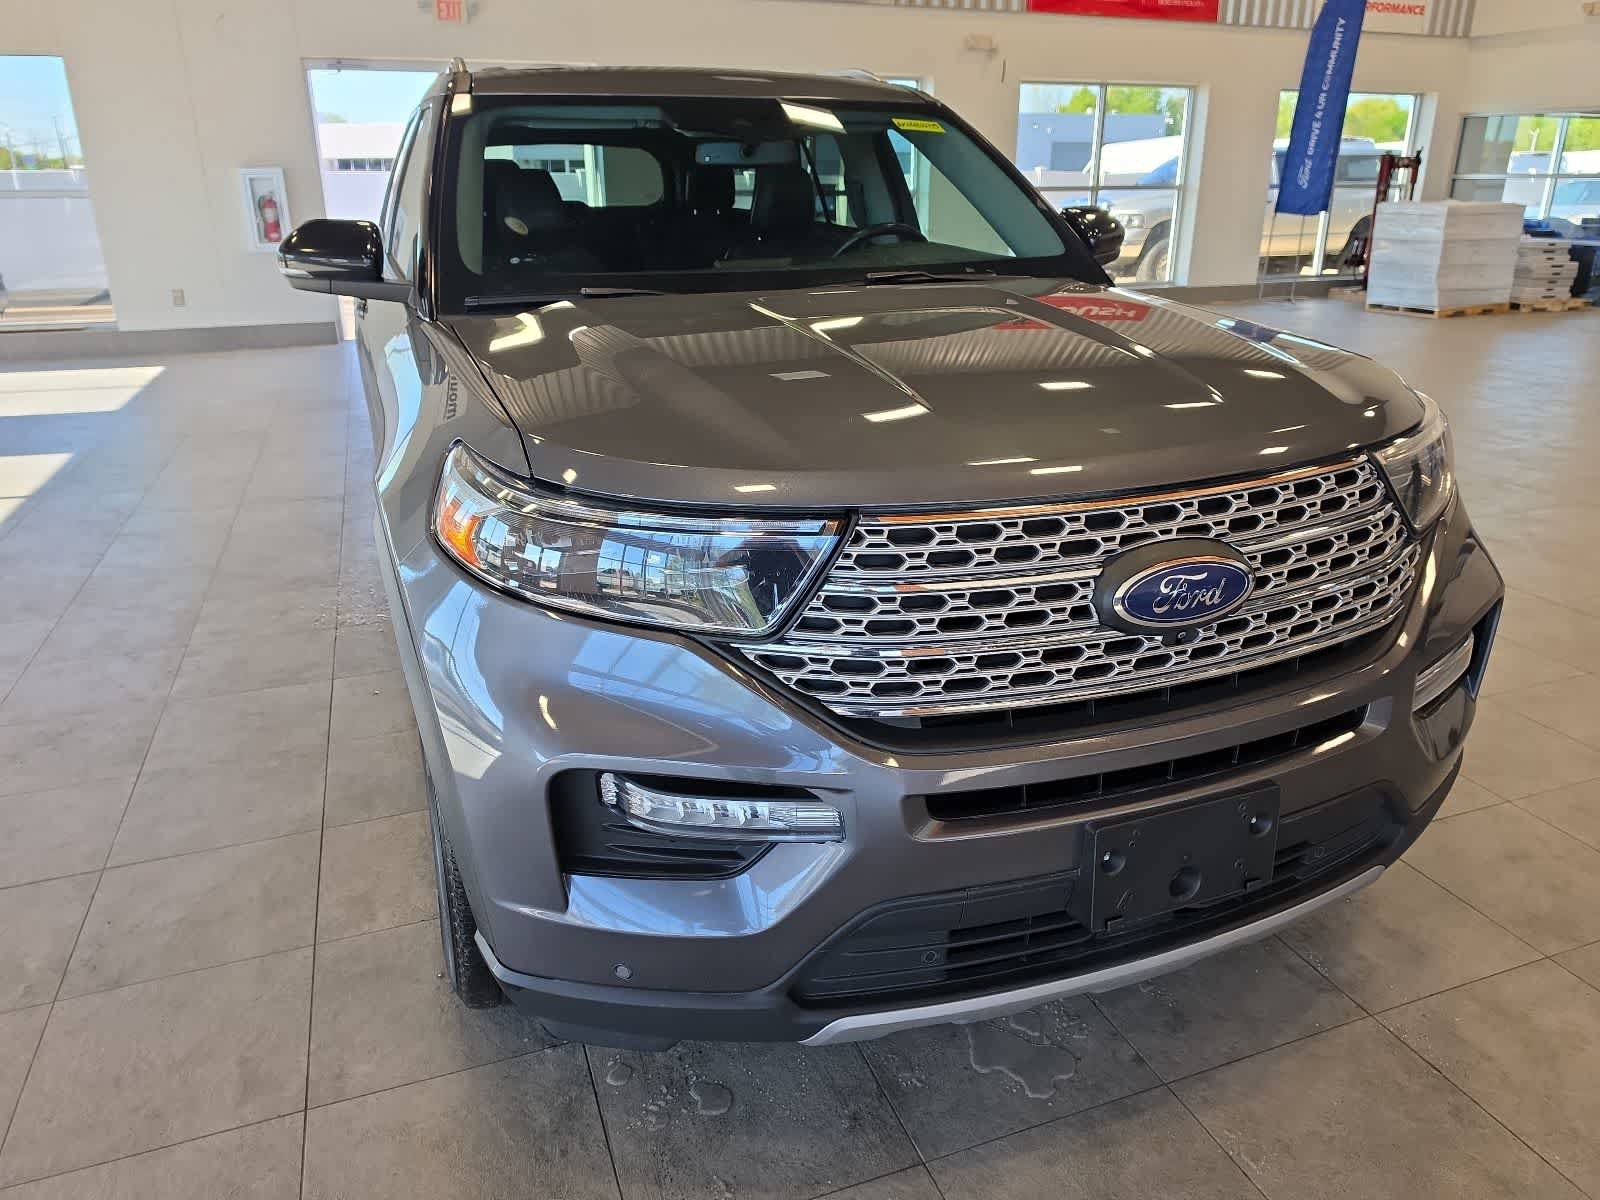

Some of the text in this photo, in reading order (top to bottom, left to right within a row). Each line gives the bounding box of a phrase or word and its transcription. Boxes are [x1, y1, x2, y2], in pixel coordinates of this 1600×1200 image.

[437, 0, 463, 22] EXIT
[1366, 1, 1425, 15] RFORMANCE
[1298, 158, 1312, 189] Ford
[1307, 120, 1321, 155] DRIVE
[1322, 17, 1346, 90] COMMUNITY
[1152, 571, 1228, 614] Ford
